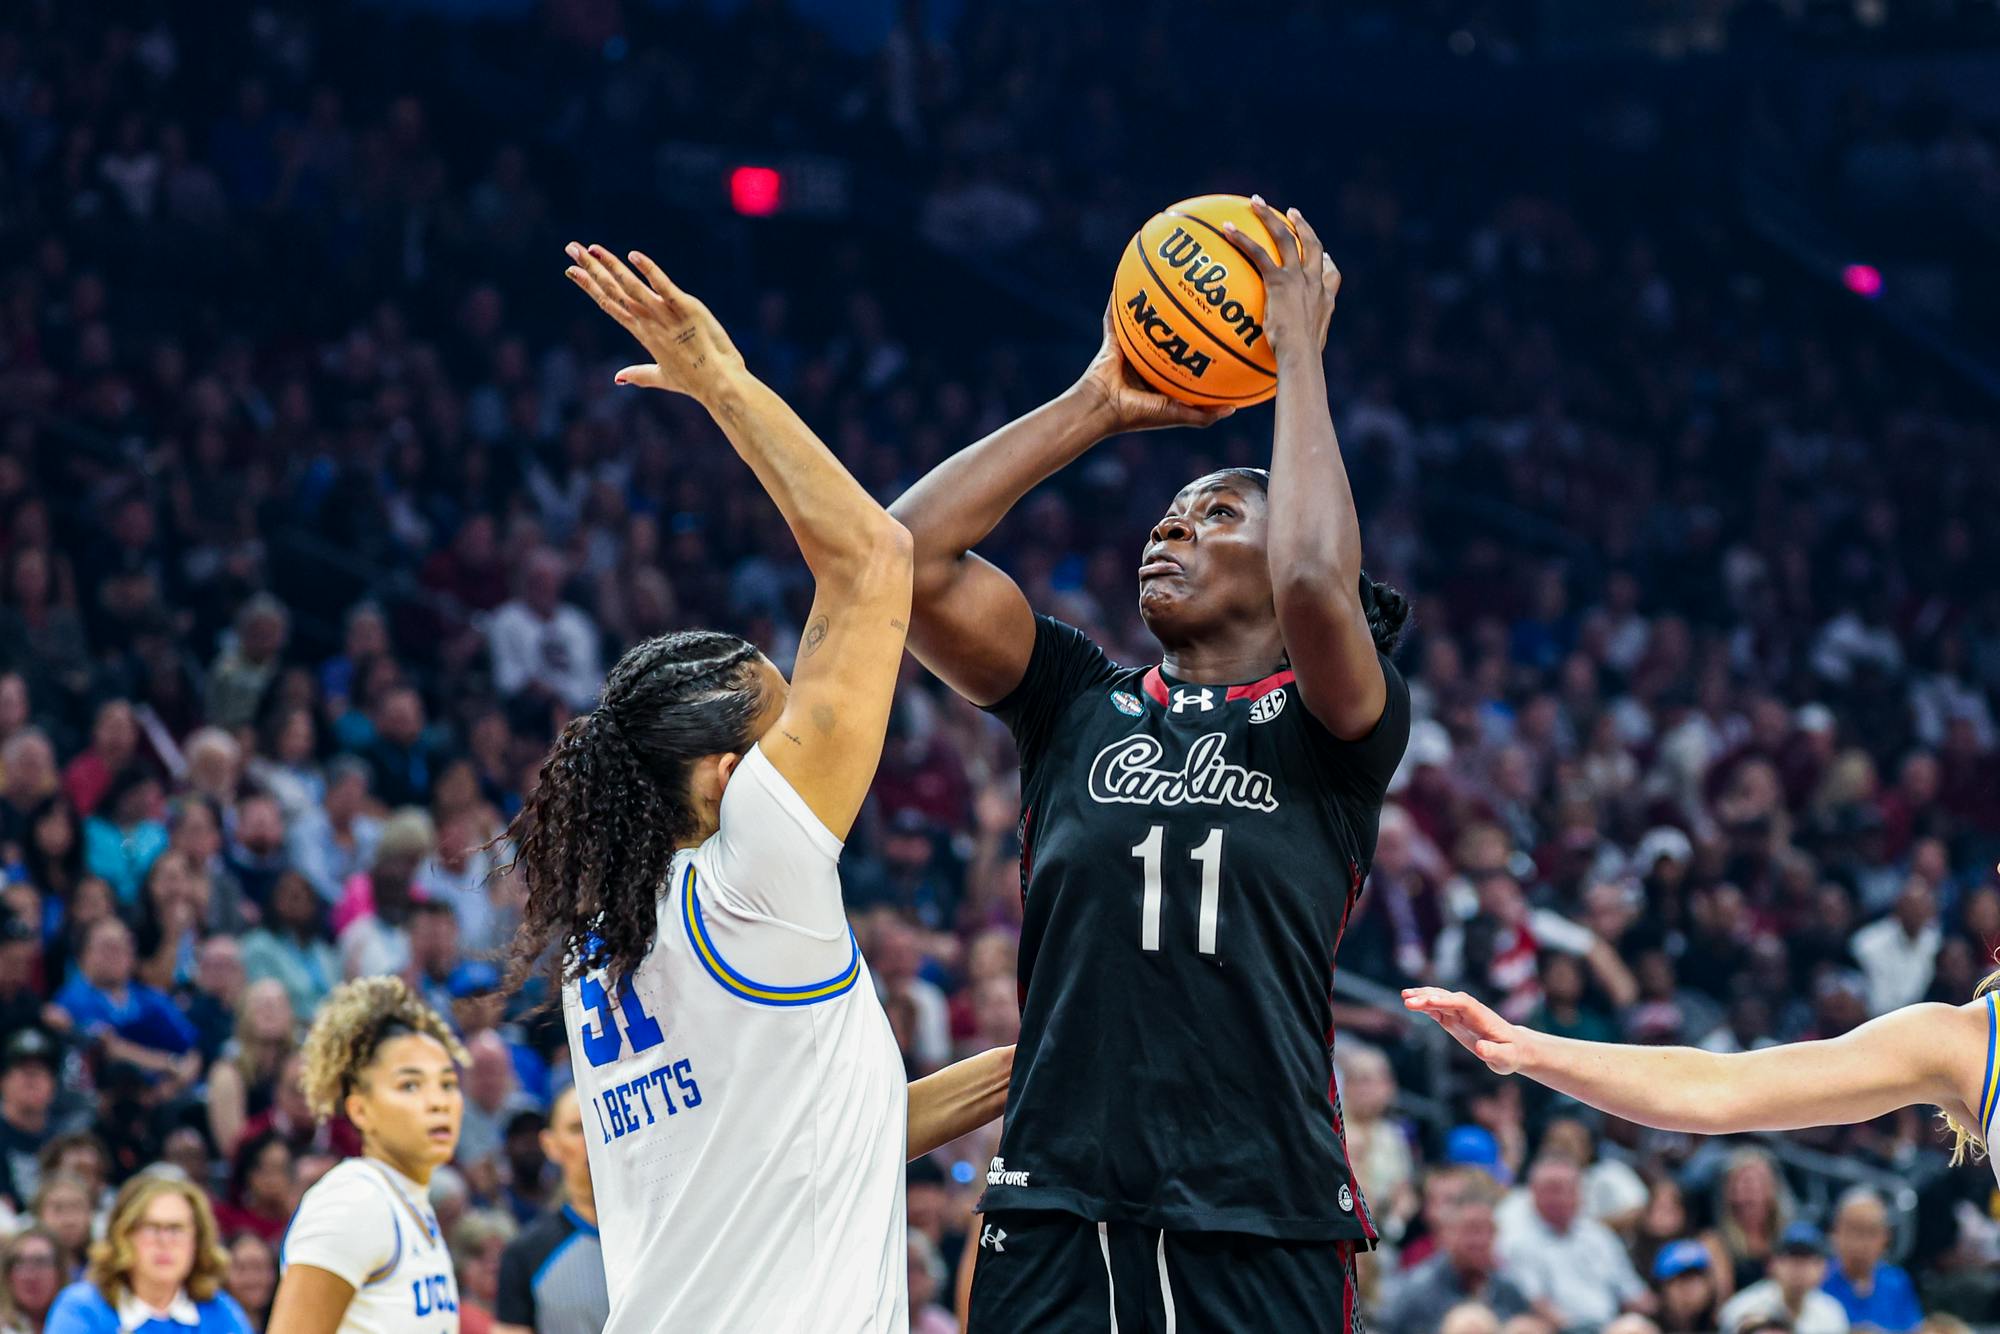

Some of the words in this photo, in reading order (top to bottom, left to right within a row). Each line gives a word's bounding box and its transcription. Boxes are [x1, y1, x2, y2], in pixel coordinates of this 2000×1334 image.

[1159, 226, 1264, 348] Wilson
[1127, 288, 1213, 379] NCAA
[1249, 690, 1284, 721] SEC
[1088, 732, 1280, 813] Carolina
[1131, 825, 1224, 955] 11
[990, 1156, 1006, 1172] THE
